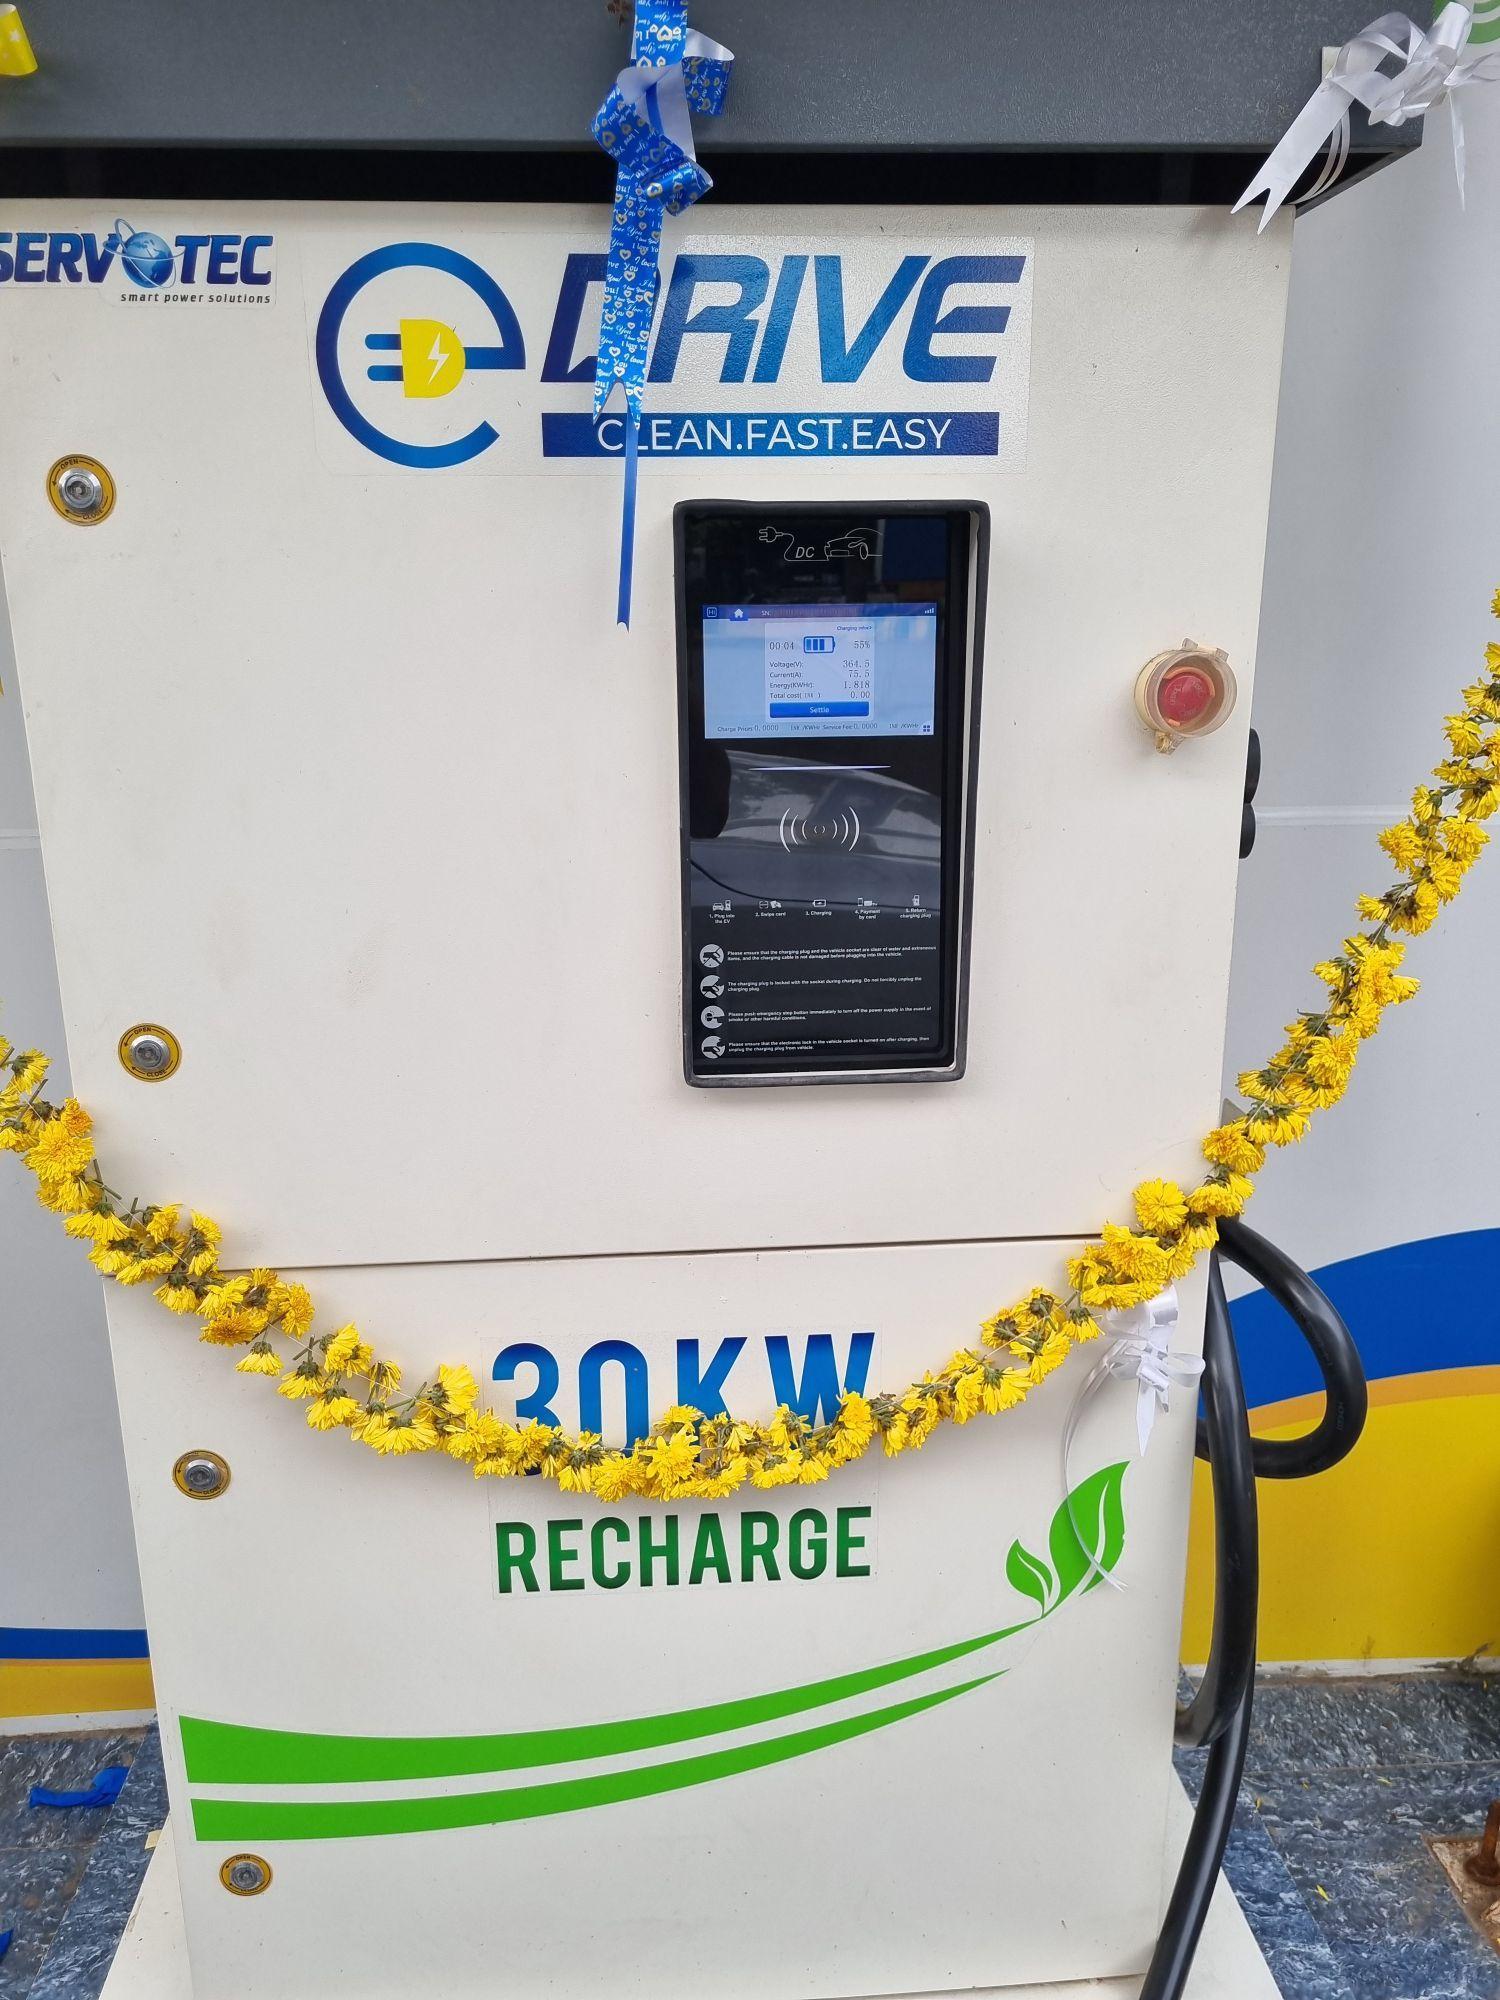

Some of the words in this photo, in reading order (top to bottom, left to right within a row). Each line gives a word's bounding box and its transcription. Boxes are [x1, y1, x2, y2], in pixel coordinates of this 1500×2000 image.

[121, 293, 159, 302] smart
[164, 294, 202, 304] power
[208, 294, 271, 304] solutions
[795, 546, 815, 559] DC
[854, 640, 870, 649] 55%
[769, 661, 803, 669] Voltage(V):
[495, 1506, 872, 1594] RECHARGE
